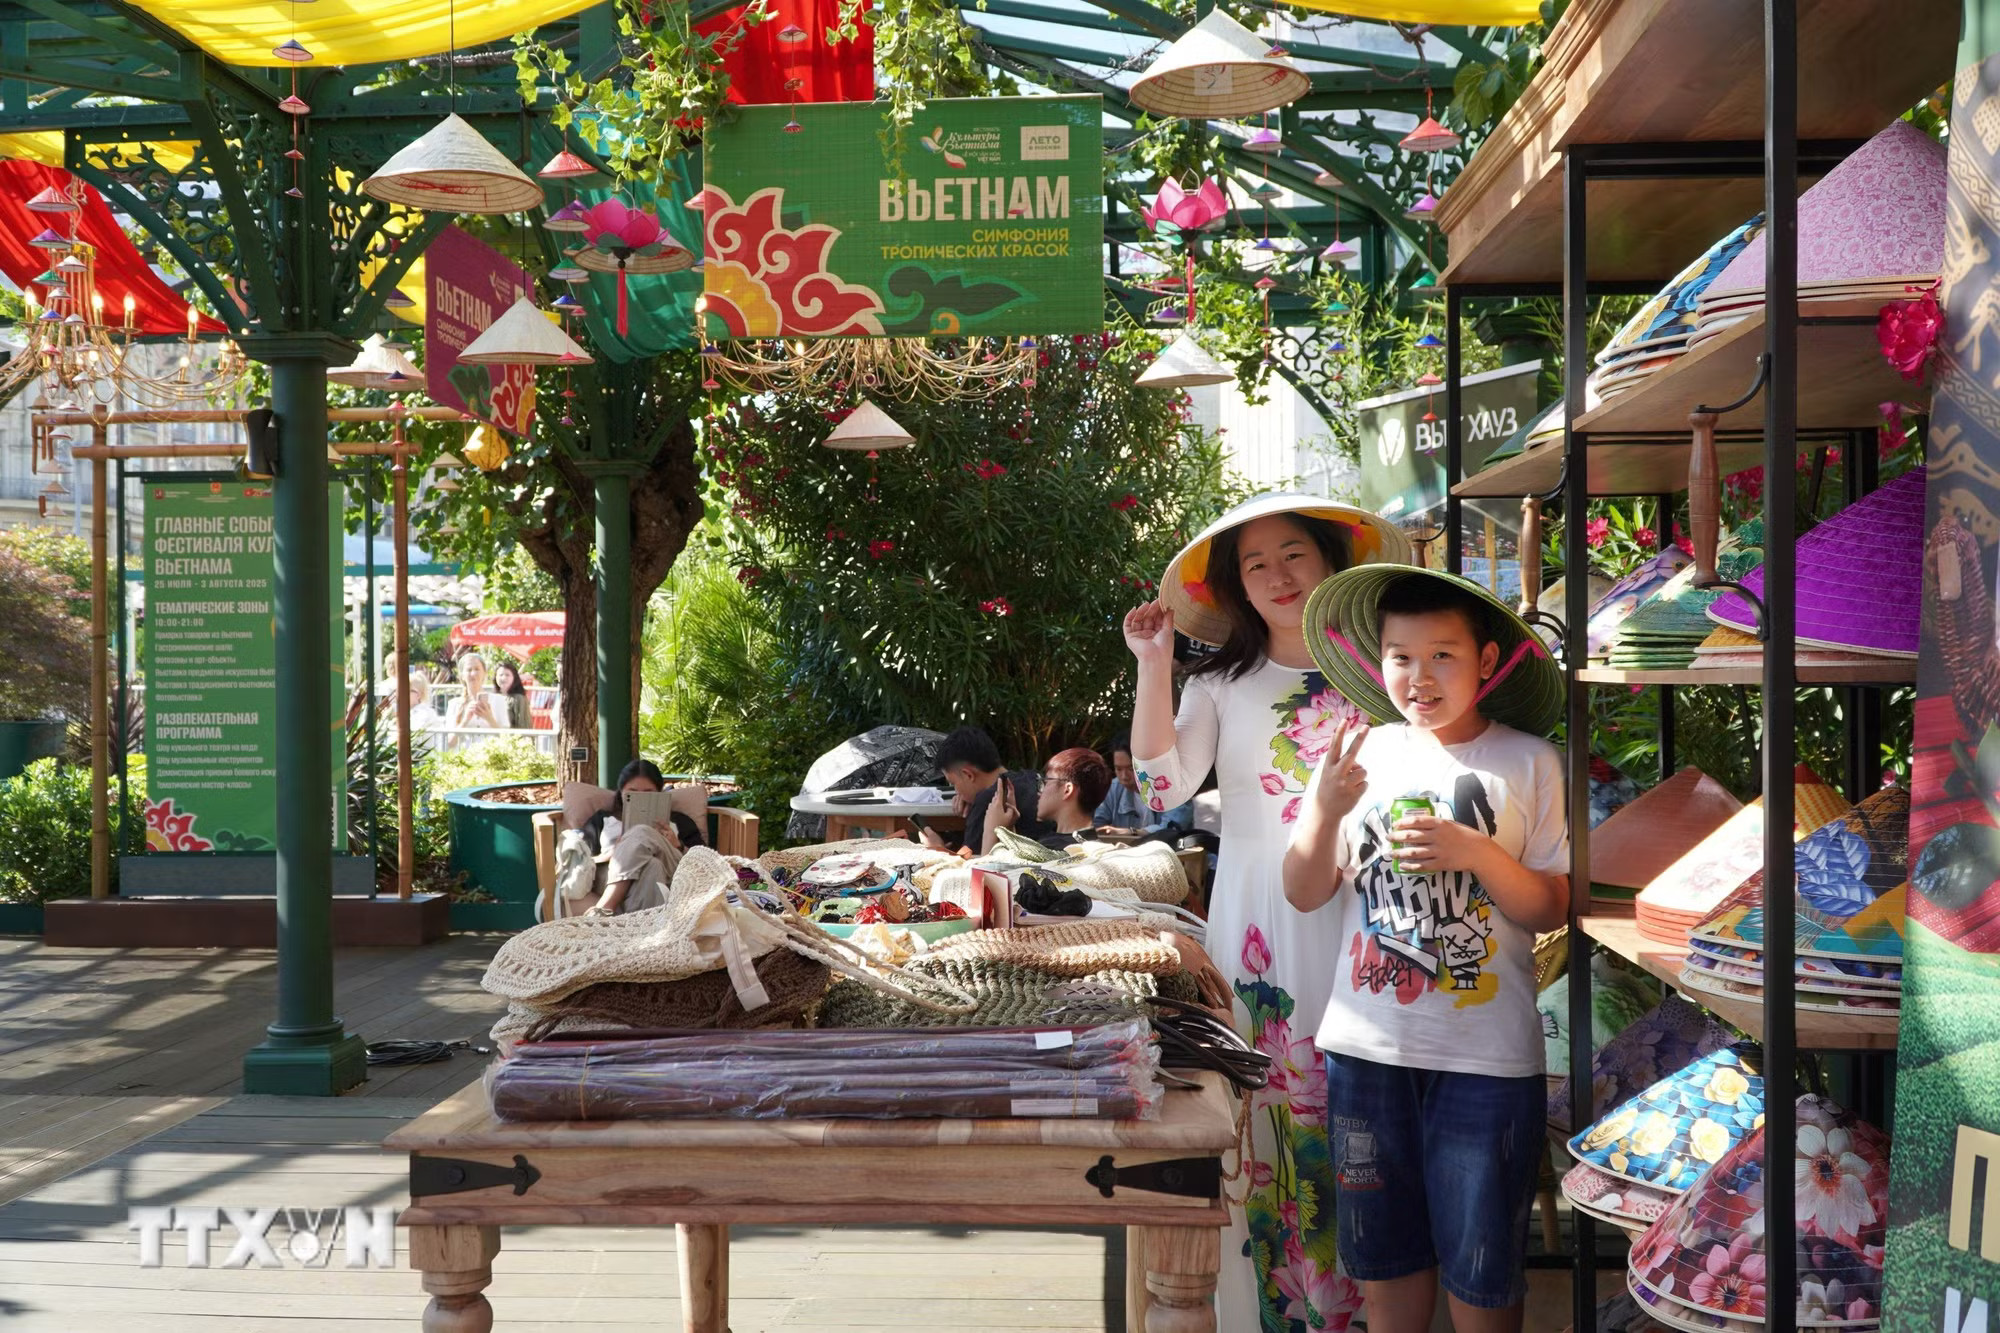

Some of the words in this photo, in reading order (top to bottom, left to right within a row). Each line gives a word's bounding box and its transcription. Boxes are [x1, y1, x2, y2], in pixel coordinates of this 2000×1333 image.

[1029, 135, 1061, 144] ЛЕТО
[879, 175, 1070, 221] ВЬЕТНАМ
[972, 228, 1069, 243] СИМФОНИЯ
[881, 243, 997, 259] ТРОПИЧЕСКИХ
[1002, 242, 1069, 257] КРАСОК
[436, 275, 492, 332] ВЬЕТНАМ
[1468, 406, 1518, 443] ХАУЗ
[155, 517, 225, 533] ГЛАВНЫЕ
[229, 516, 274, 533] СОБЫ
[155, 537, 243, 554] ФЕСТИВАЛЯ
[155, 558, 232, 575] ВЬЕТНАМА
[154, 580, 166, 588] 25
[201, 580, 206, 588] 3
[209, 579, 243, 588] АВГУСТА
[246, 579, 267, 588] 2025
[155, 602, 235, 614] ТЕМАТИЧЕСКИЕ
[237, 601, 269, 613] ЗОНЫ
[156, 713, 259, 725] РАЗВЛЕКАТЕЛЬНАЯ
[156, 727, 222, 739] ПРОГРАММА
[1345, 1168, 1377, 1178] NEVER
